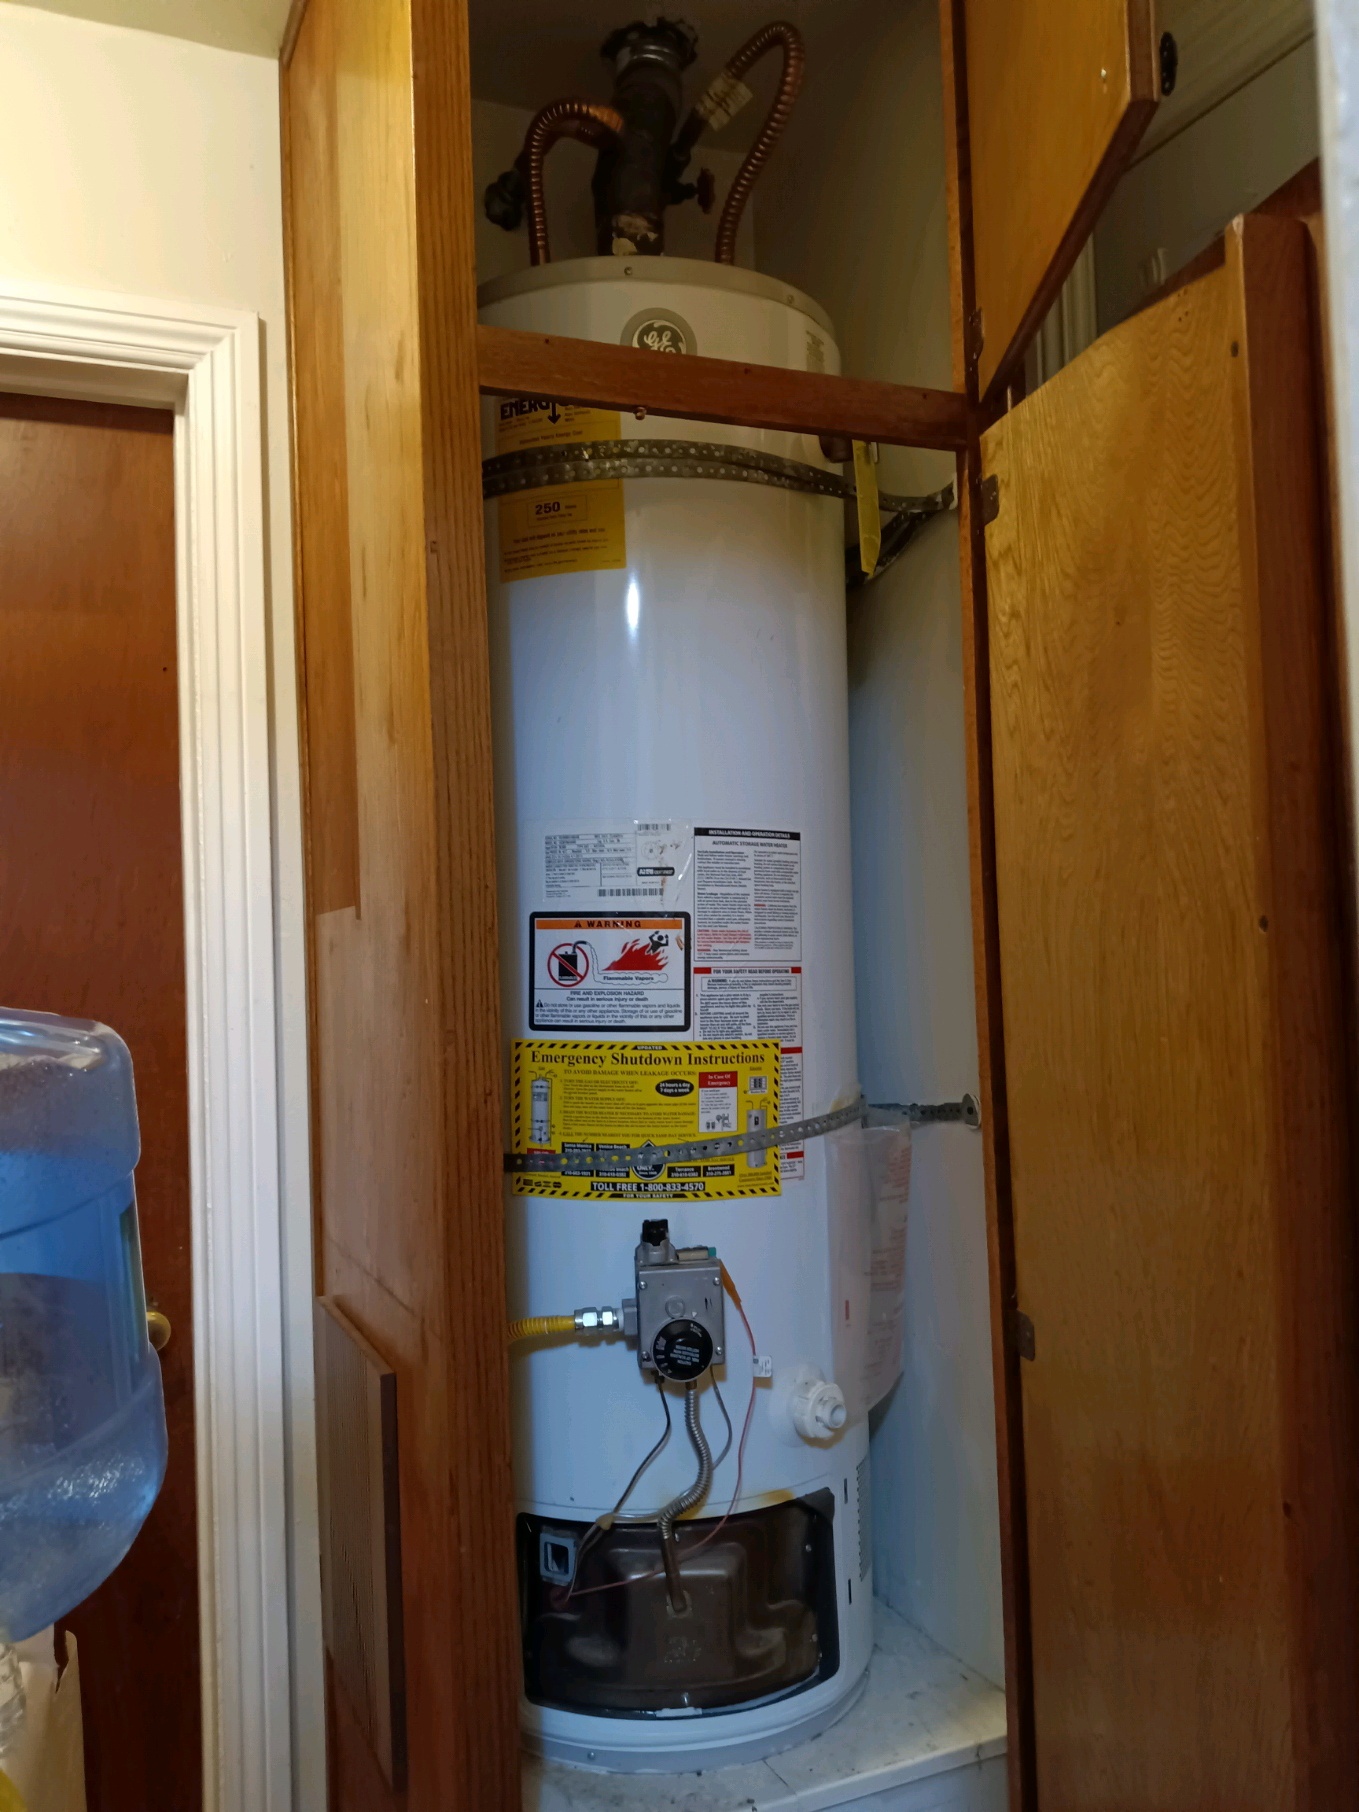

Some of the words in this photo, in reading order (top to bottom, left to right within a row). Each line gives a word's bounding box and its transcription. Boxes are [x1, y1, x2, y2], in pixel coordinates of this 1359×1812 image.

[535, 502, 560, 515] 250
[532, 1050, 606, 1068] Emergency
[611, 1052, 682, 1066] Shutdown
[688, 1052, 765, 1065] Instructions
[593, 1182, 614, 1191] TOLL
[616, 1182, 638, 1191] FREE
[640, 1182, 704, 1191] 1-800-833-4570
